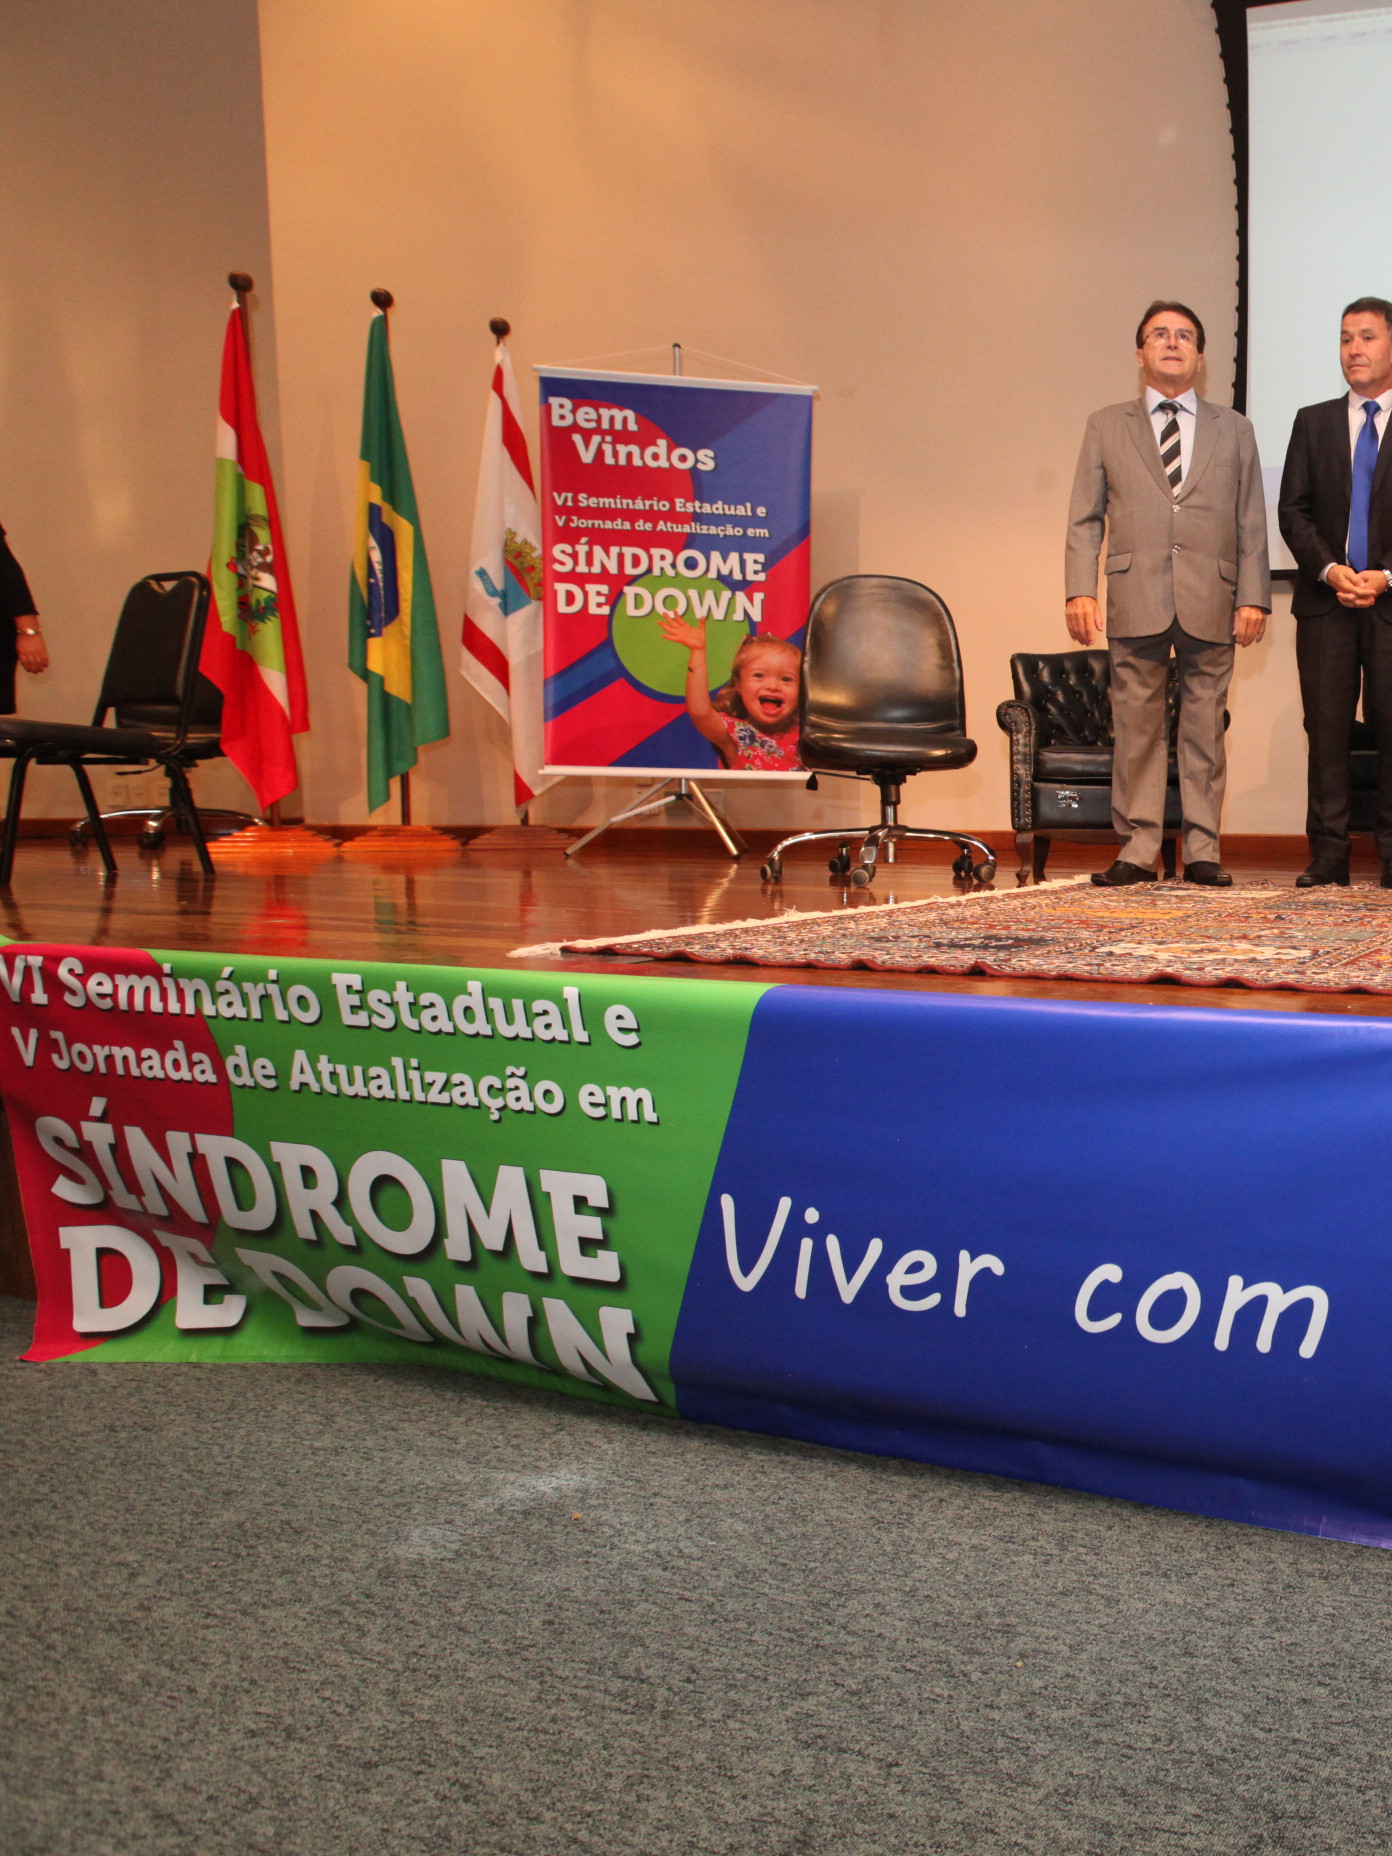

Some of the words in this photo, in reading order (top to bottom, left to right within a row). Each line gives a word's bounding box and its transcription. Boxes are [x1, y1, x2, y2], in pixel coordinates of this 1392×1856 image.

[547, 396, 639, 432] Bem
[572, 433, 717, 472] Vindos
[552, 492, 574, 507] VI
[577, 493, 671, 512] Seminário
[674, 498, 752, 517] Estadual
[756, 505, 768, 517] e
[554, 515, 567, 527] V
[569, 516, 632, 531] Jornada
[634, 519, 653, 532] de
[656, 520, 744, 538] Atualização
[746, 527, 770, 538] em
[551, 537, 768, 582] SÍNDROME
[553, 582, 611, 616] DE
[622, 585, 766, 623] DOWN
[0, 954, 49, 1005] VI
[57, 956, 322, 1025] Seminário
[331, 972, 591, 1045] Estadual
[604, 1003, 641, 1048] e
[11, 1026, 38, 1068] V
[49, 1029, 218, 1085] Jornada
[225, 1044, 278, 1090] de
[289, 1049, 566, 1122] Atualização
[578, 1082, 659, 1123] em
[35, 1096, 622, 1284] SÍNDROME
[720, 1193, 1005, 1318] Viver
[1074, 1263, 1329, 1359] com
[58, 1224, 247, 1333] DE
[234, 1247, 660, 1402] DOWN
